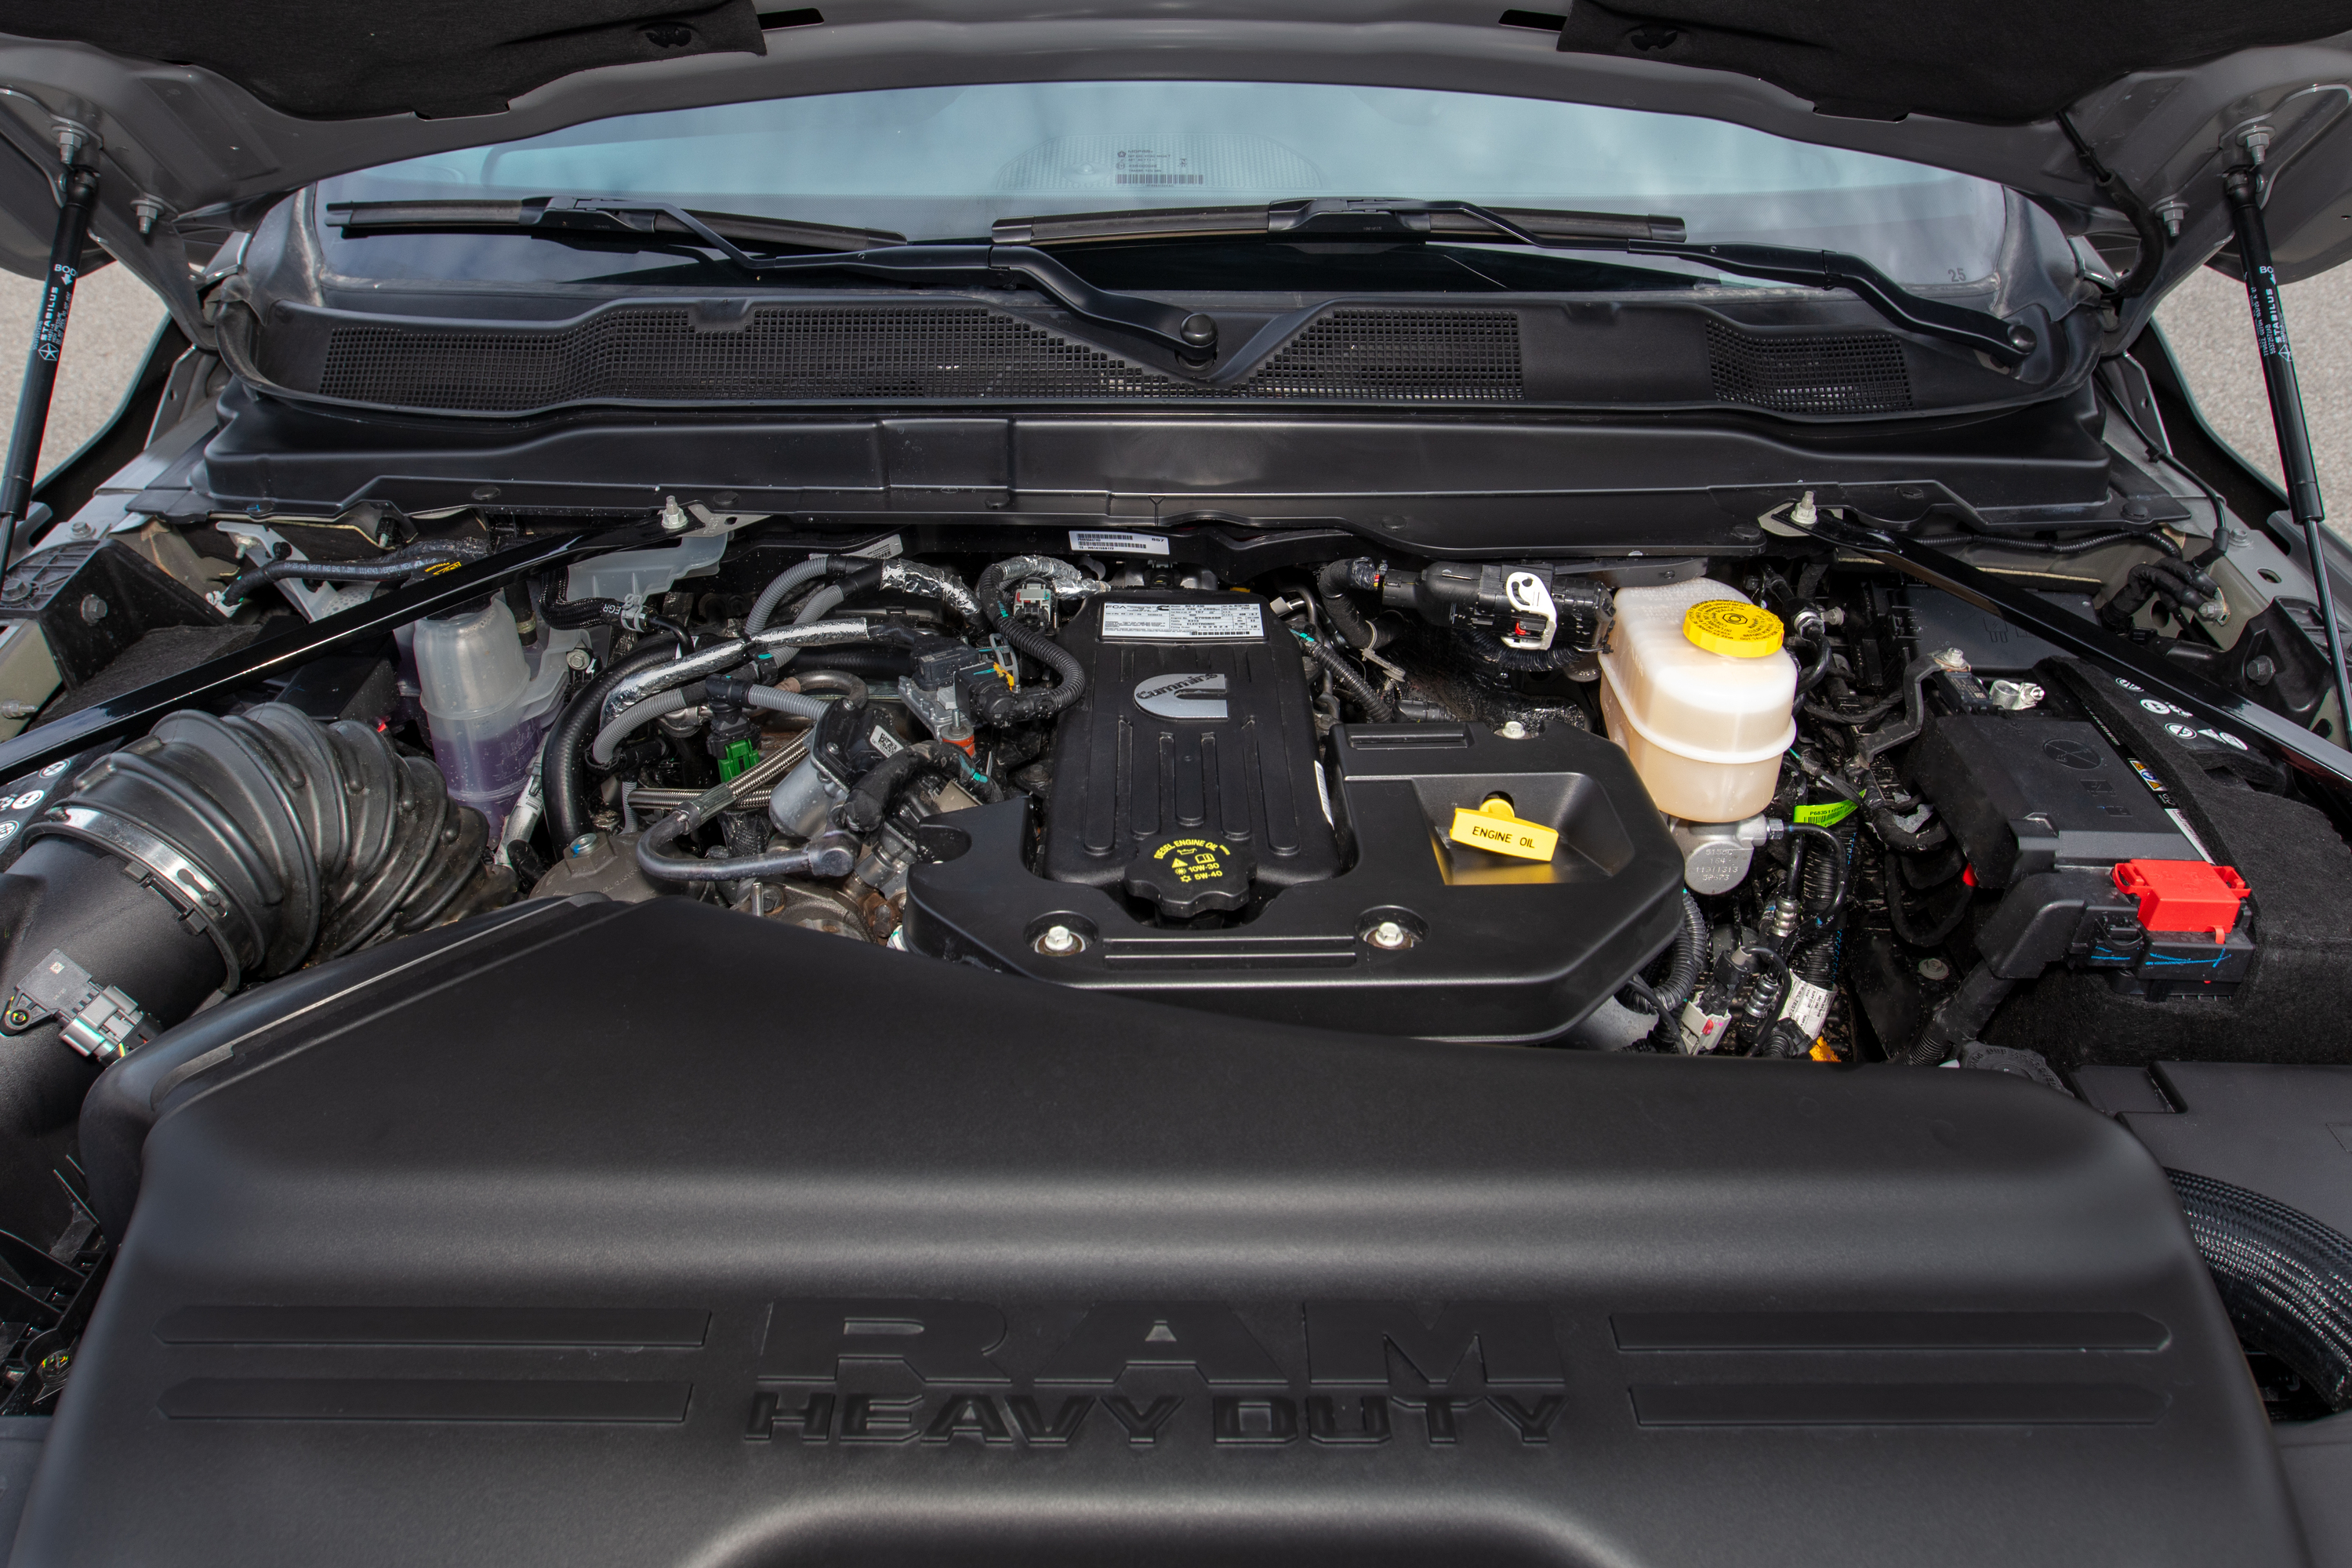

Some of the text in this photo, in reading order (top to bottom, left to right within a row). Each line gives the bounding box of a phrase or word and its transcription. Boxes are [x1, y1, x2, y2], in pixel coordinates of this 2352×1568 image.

[54, 263, 78, 277] BOD
[1947, 267, 1967, 282] 25
[40, 286, 59, 341] STABILUS
[2265, 288, 2282, 343] STABILUS
[401, 562, 413, 570] MEX
[603, 603, 622, 615] EGR
[1136, 673, 1218, 699] Cummins
[1472, 826, 1535, 848] ENGINE OIL
[1154, 843, 1176, 859] DIESEL
[1173, 839, 1206, 847] ENGINE
[1205, 842, 1218, 851] OIL
[1188, 862, 1220, 873] 10W-30
[1194, 870, 1223, 880] 5W-40
[757, 1298, 1567, 1388] RAM
[743, 1391, 1569, 1447] HEAVY DUTY
